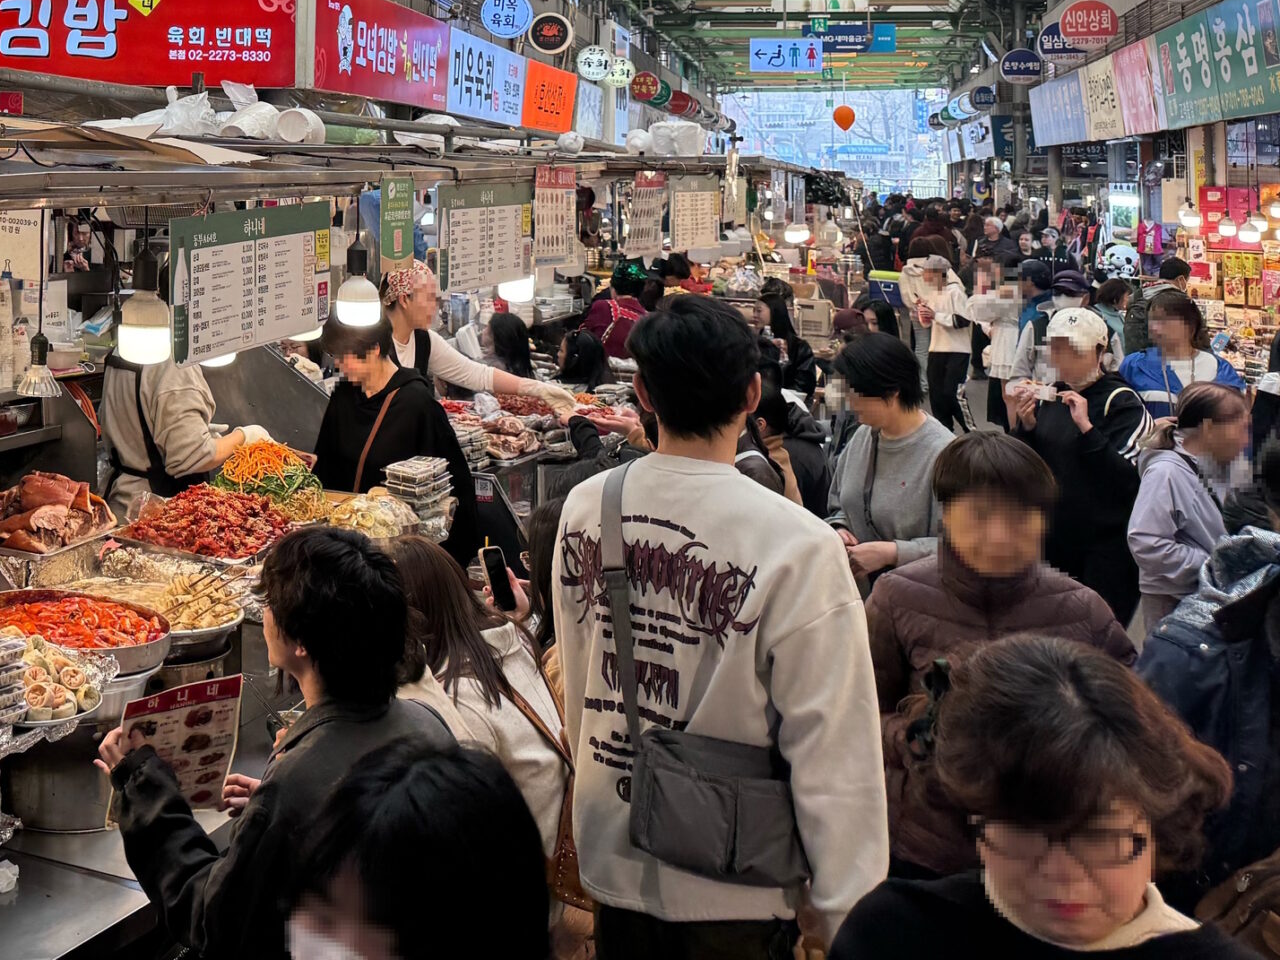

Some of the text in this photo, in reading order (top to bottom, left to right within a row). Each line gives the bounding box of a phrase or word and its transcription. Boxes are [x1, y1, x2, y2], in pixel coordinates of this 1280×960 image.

[490, 14, 516, 29] 육회
[1064, 10, 1113, 33] 신안상회
[168, 49, 271, 63] 본점 02-2273-8330
[355, 20, 398, 76] 모녀김밥
[412, 39, 441, 87] 빈대떡
[1175, 2, 1259, 94] 동명홍삼
[453, 43, 495, 111] 미옥육회
[243, 217, 265, 236] 하니네
[147, 683, 219, 709] 하니네
